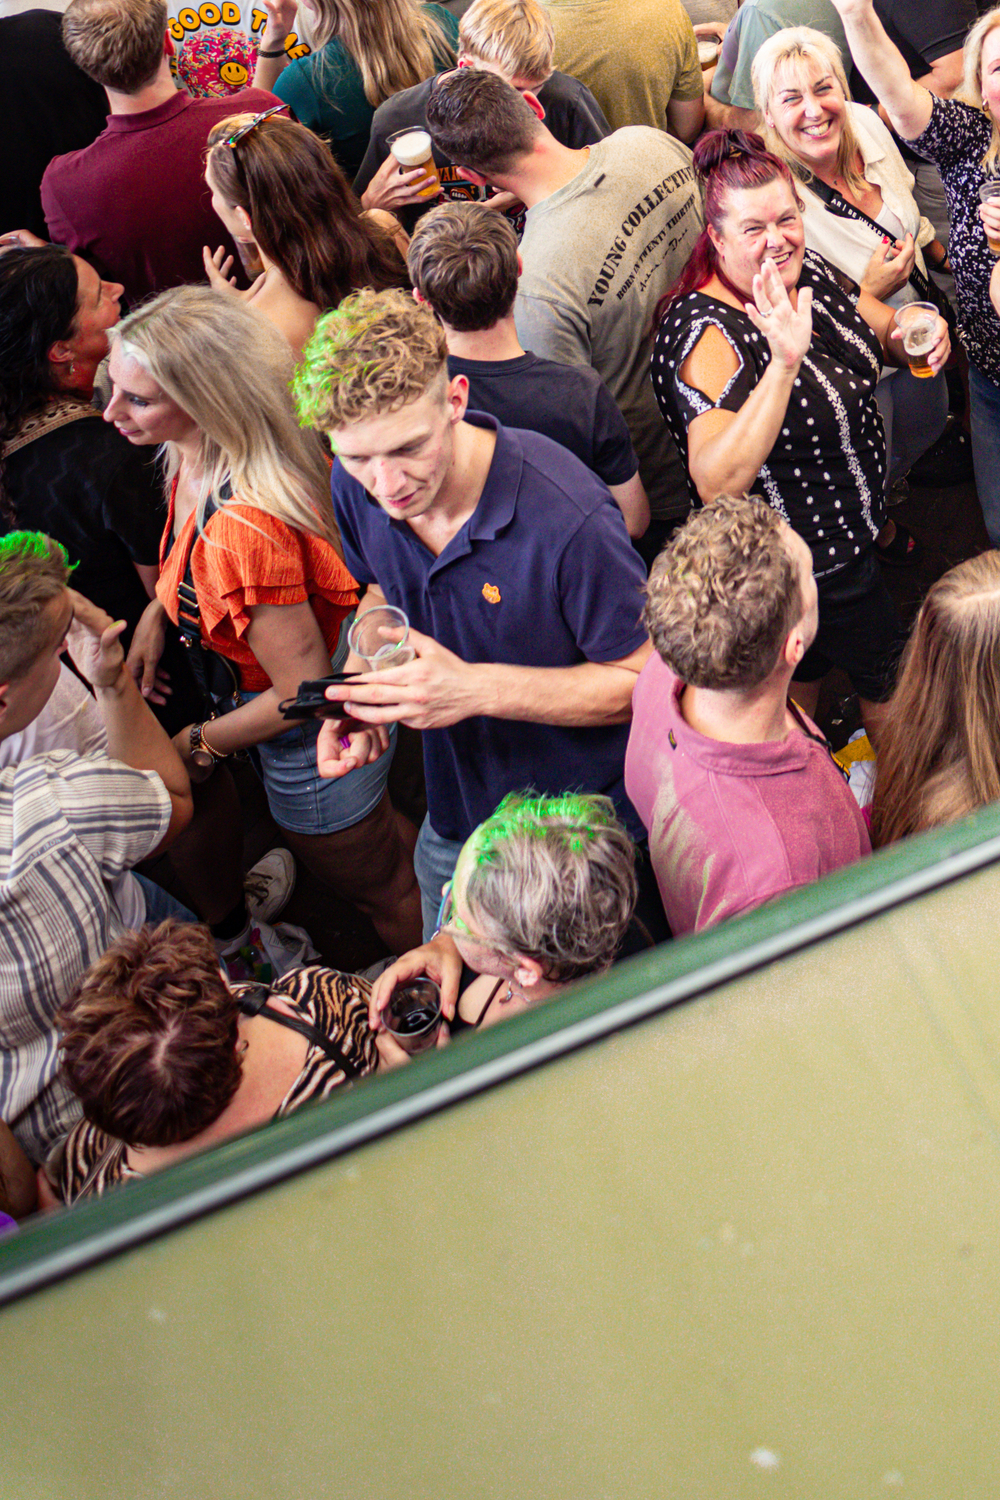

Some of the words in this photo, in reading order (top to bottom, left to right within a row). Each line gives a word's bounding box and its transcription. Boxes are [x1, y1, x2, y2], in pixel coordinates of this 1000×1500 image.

[167, 1, 242, 42] GOOD
[848, 208, 858, 218] BE
[587, 235, 627, 307] YOUNG
[616, 273, 636, 300] BORN
[633, 262, 641, 274] IN
[639, 227, 667, 264] TWENTY
